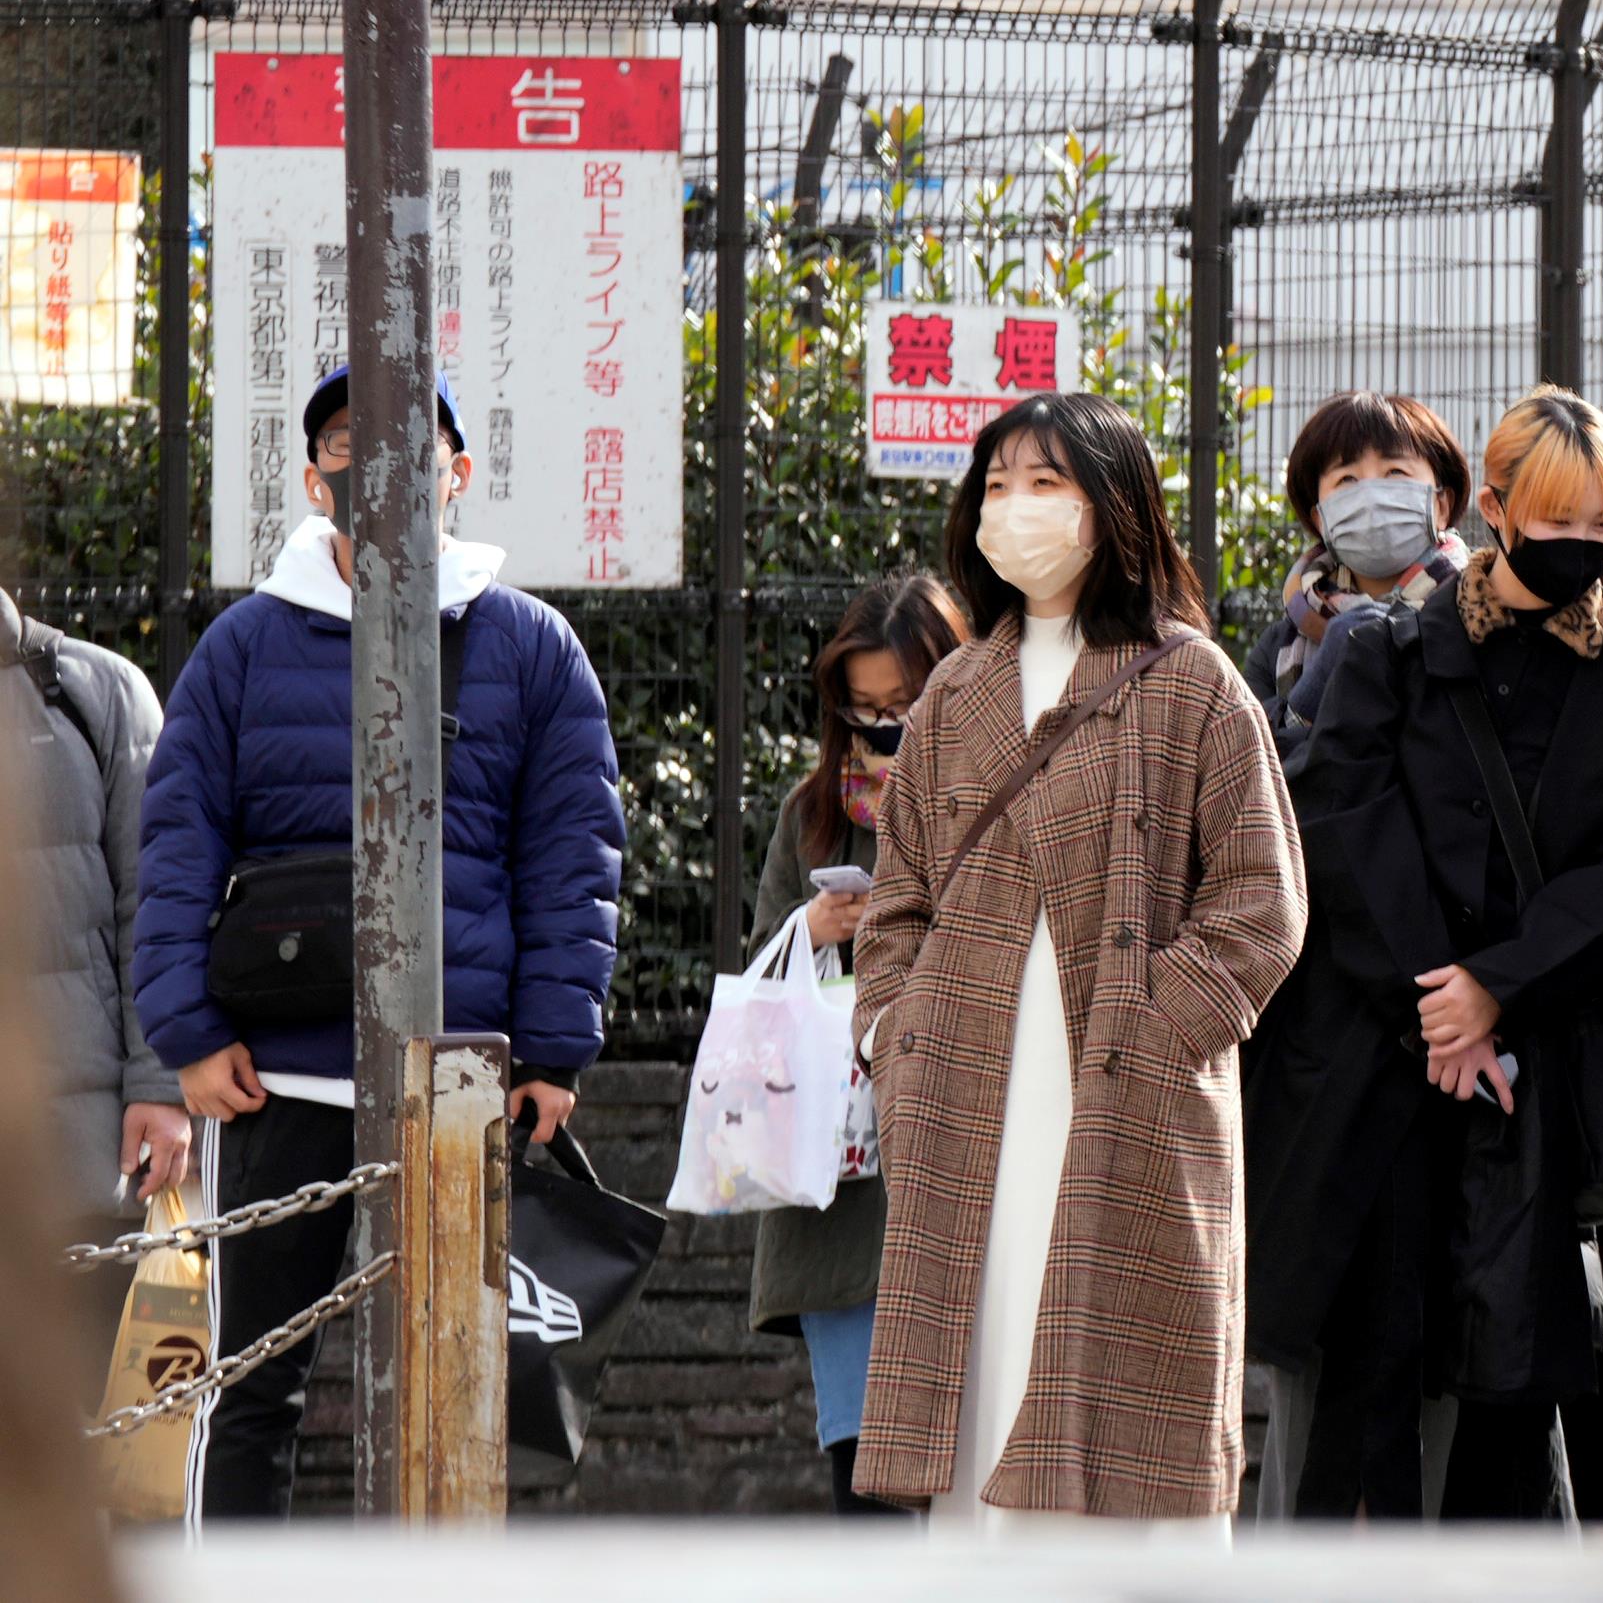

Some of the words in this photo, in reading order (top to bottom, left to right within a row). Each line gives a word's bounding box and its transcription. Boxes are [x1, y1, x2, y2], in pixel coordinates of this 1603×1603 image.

[582, 161, 625, 398] 路上ライブ等
[889, 313, 1057, 391] 禁煙
[582, 427, 625, 582] 露店禁止
